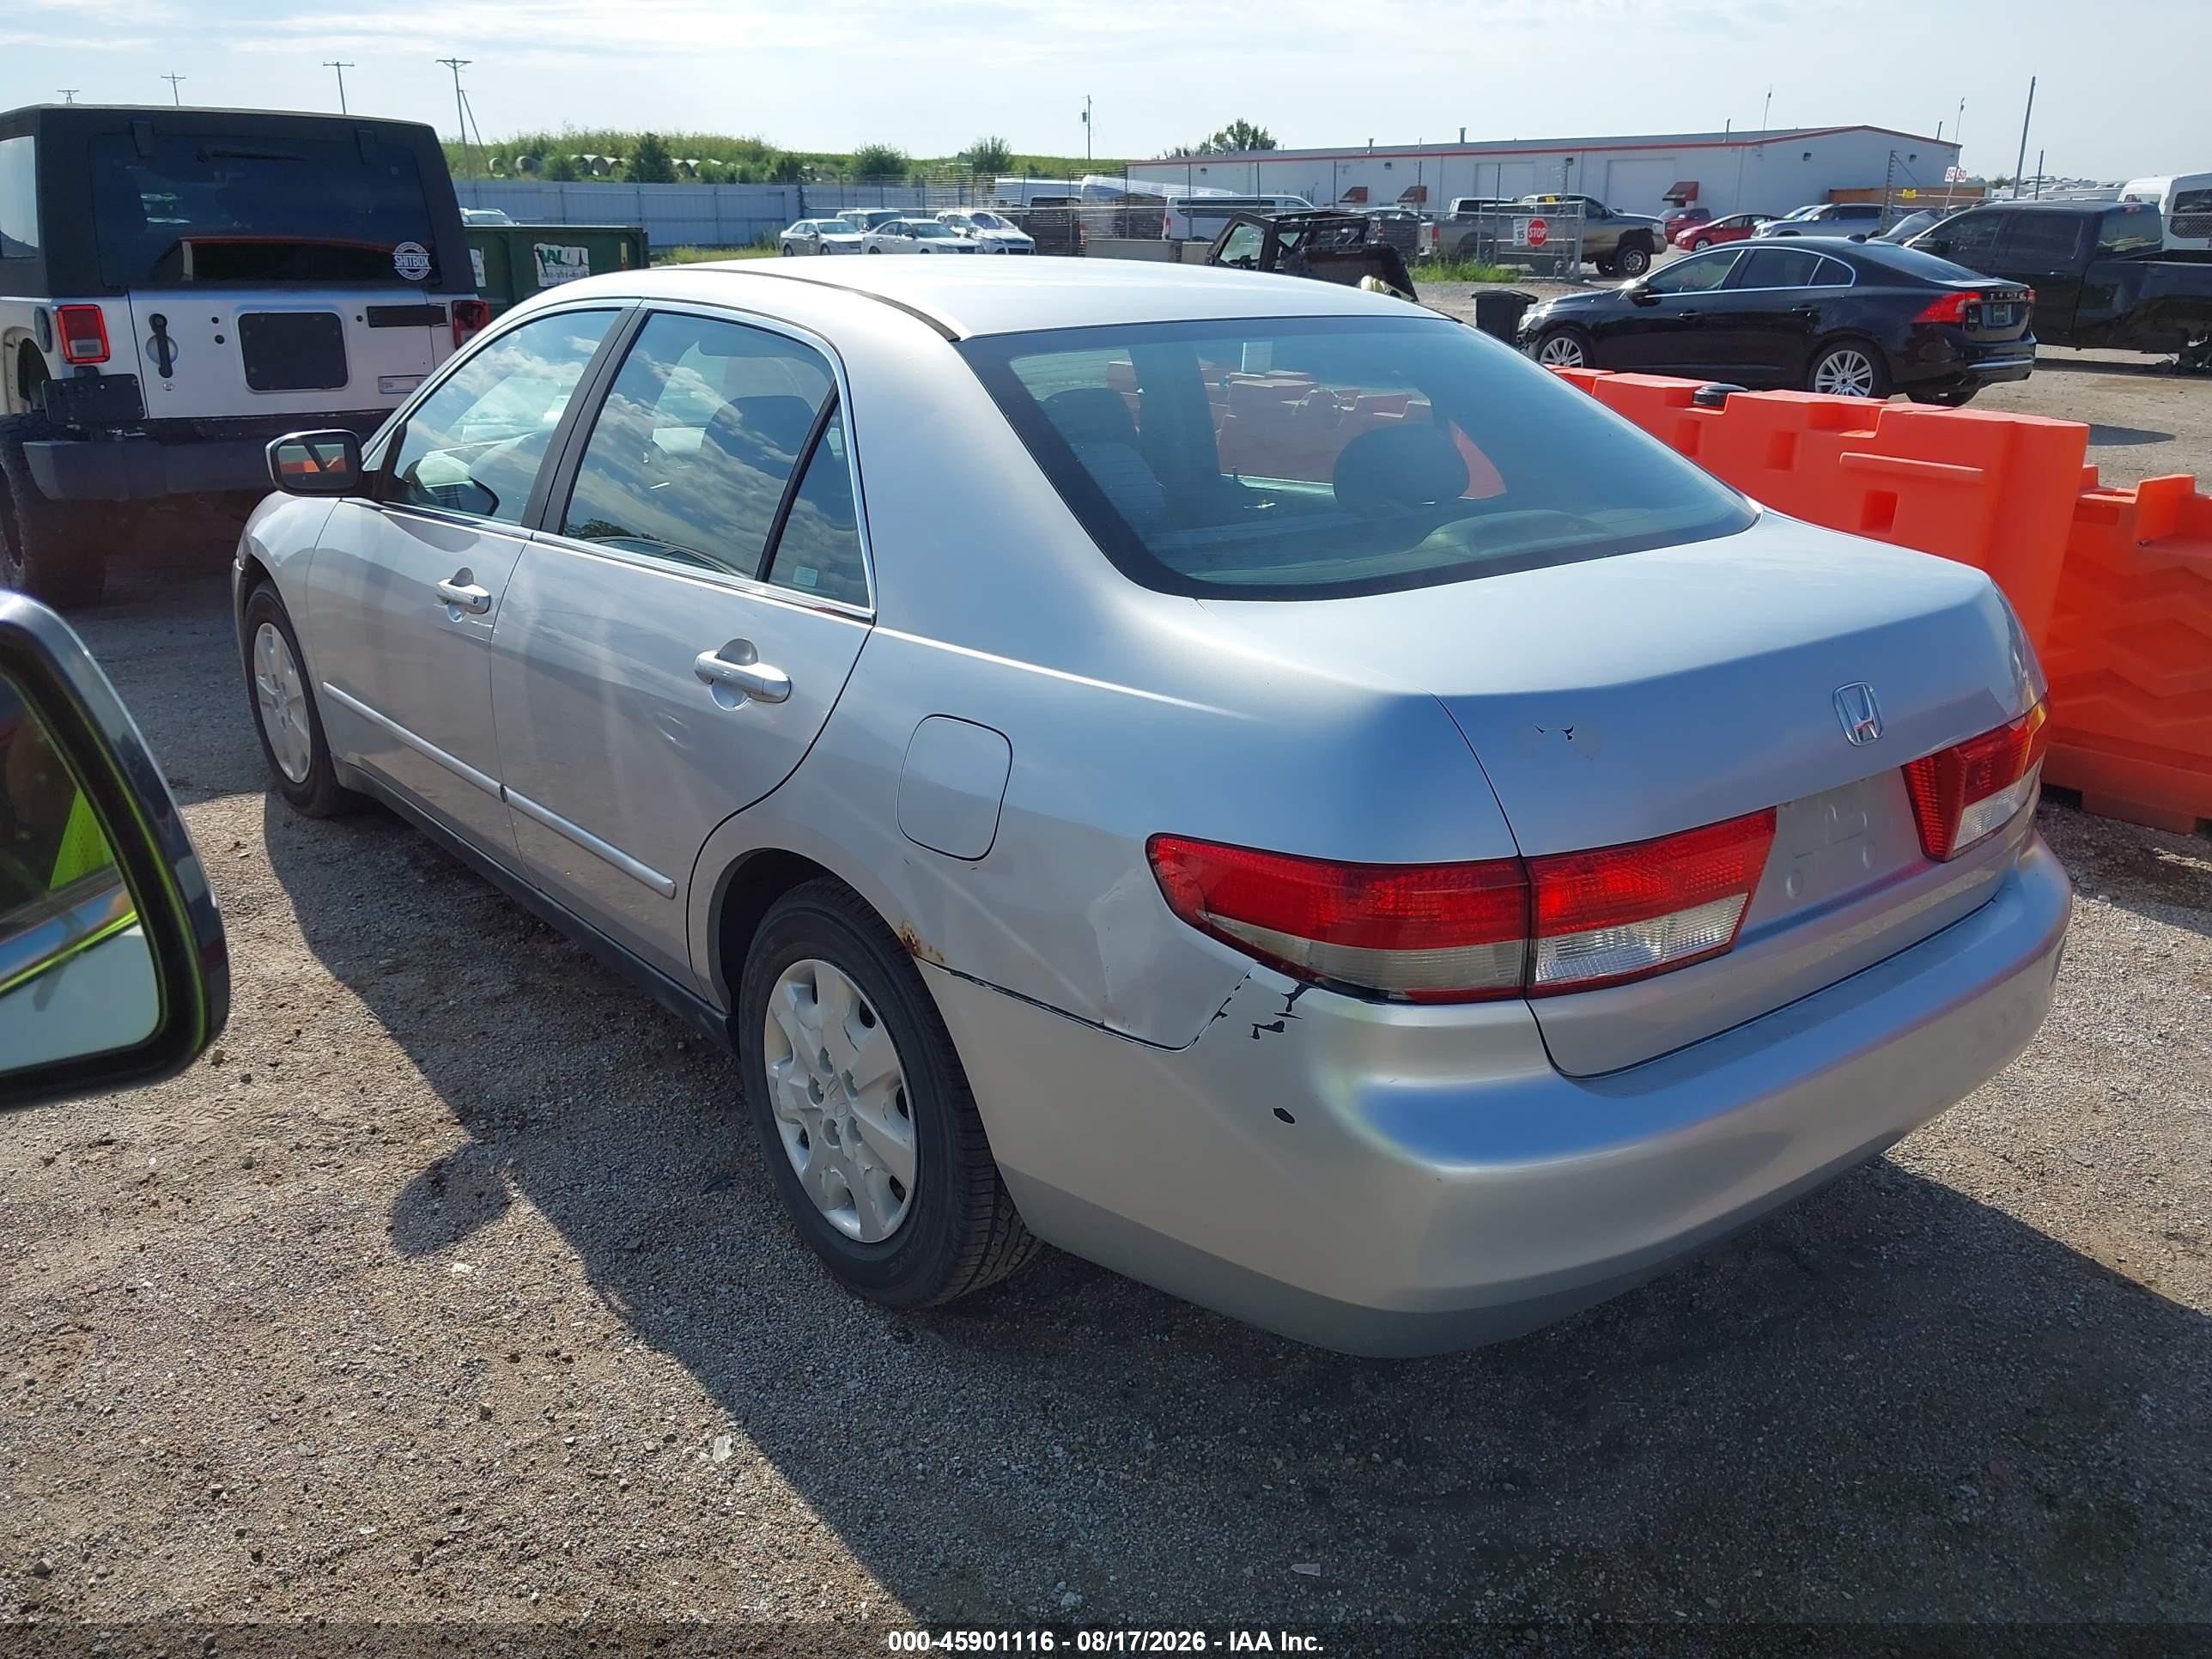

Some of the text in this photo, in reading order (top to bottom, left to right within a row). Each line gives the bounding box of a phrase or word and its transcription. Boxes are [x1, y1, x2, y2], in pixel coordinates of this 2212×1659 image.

[1516, 230, 1525, 239] 15
[1528, 228, 1547, 238] STOP
[394, 255, 429, 267] SHITBOX
